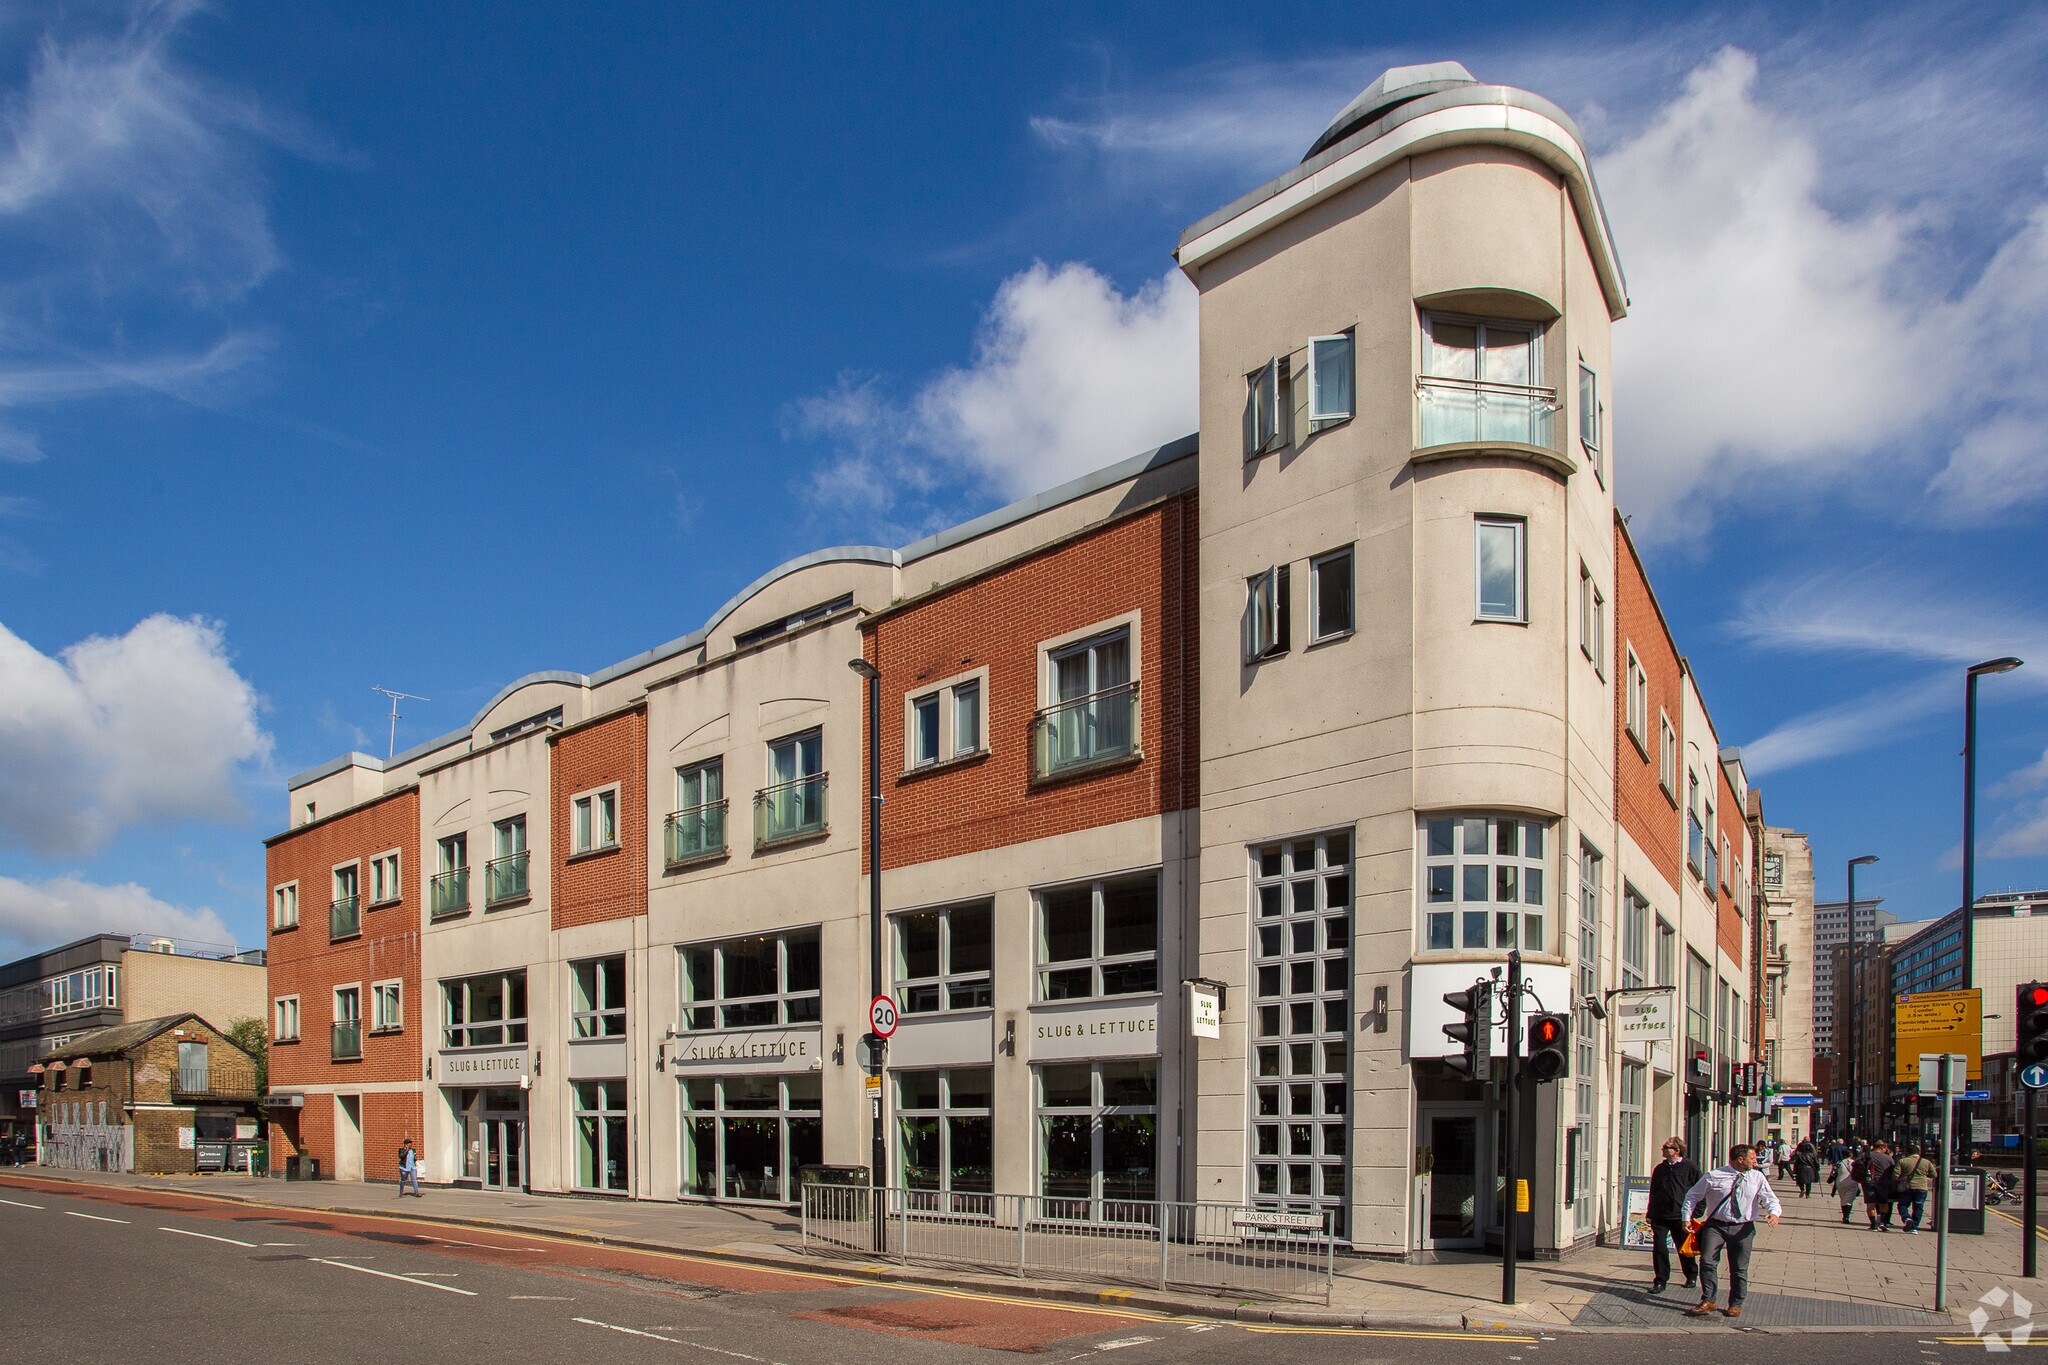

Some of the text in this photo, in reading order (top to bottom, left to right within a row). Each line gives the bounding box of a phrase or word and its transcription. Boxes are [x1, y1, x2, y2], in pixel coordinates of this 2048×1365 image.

[1201, 1000, 1211, 1008] SLUG
[1634, 1006, 1658, 1014] SLUG
[875, 1008, 894, 1025] 20
[1197, 1017, 1215, 1026] LETTUCE
[1038, 1019, 1156, 1038] SLUG & LETTUCE
[1624, 1021, 1666, 1031] LETTUCE
[692, 1042, 806, 1060] SLUG & LETTUCE
[450, 1058, 519, 1072] SLUG & LETTUCE
[1245, 1212, 1270, 1222] PARK
[1273, 1215, 1310, 1225] STREET
